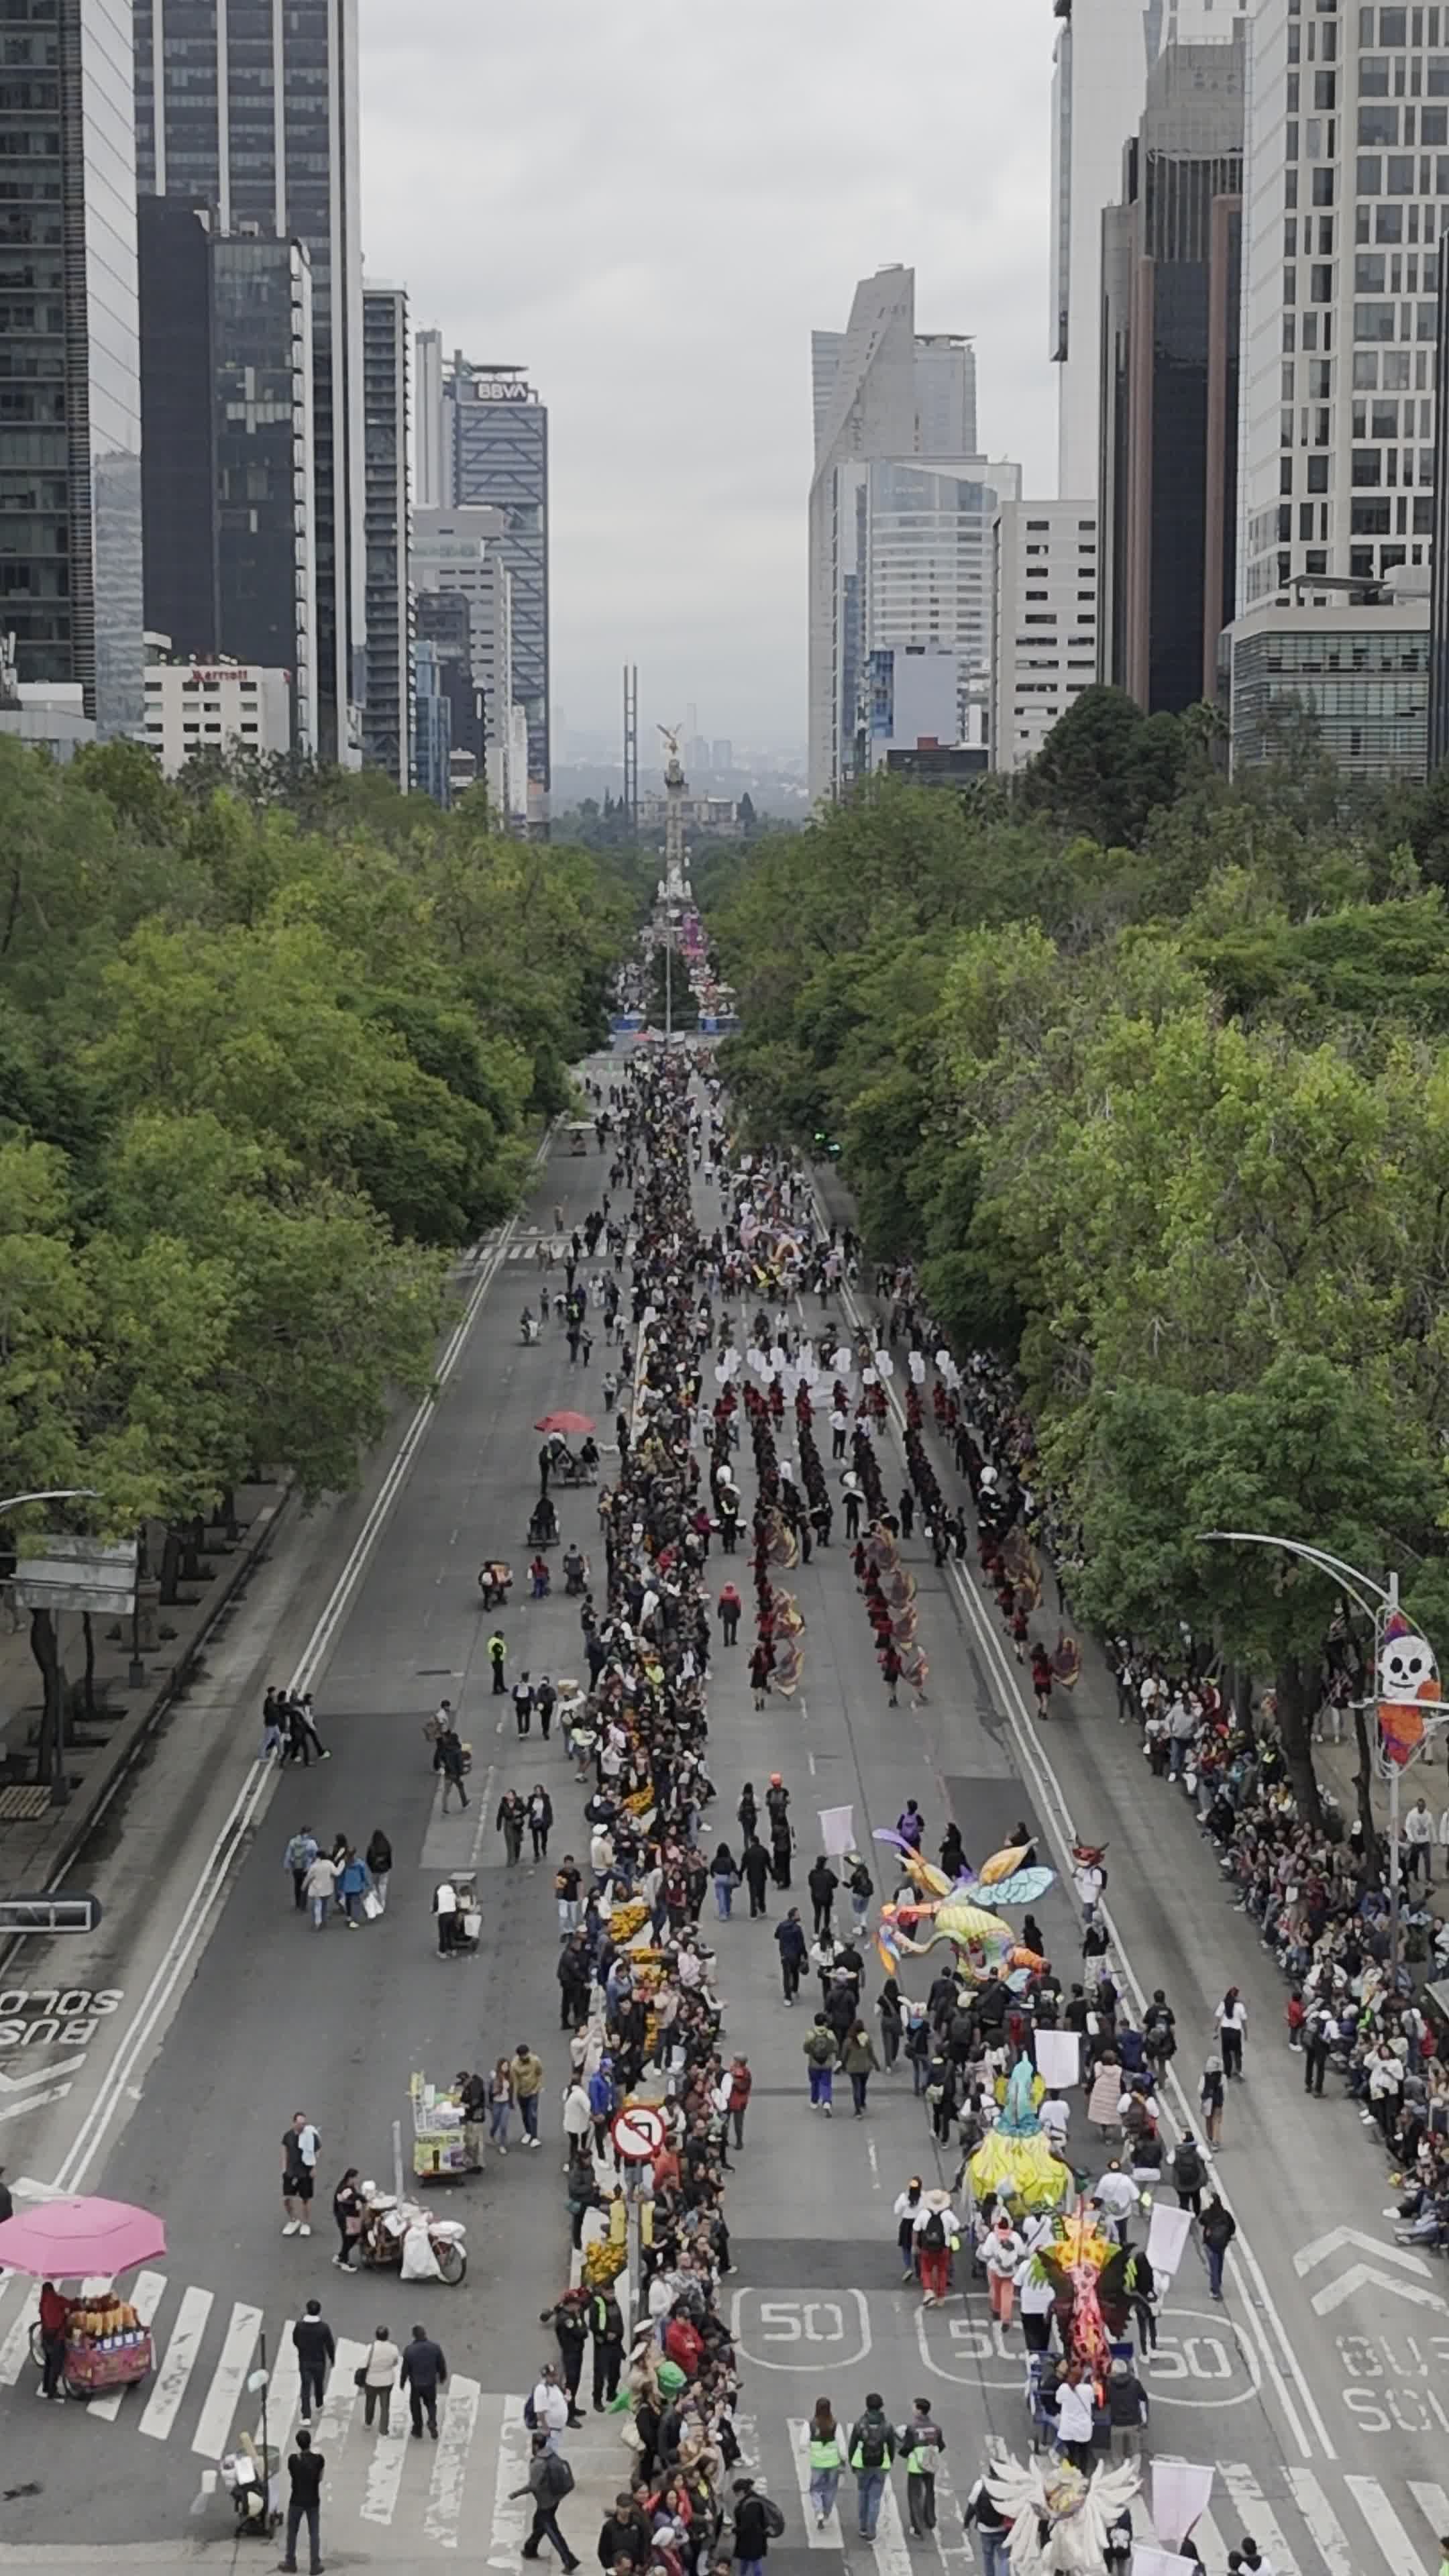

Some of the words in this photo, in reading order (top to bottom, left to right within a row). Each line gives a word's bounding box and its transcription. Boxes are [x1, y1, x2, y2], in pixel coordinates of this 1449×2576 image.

[478, 383, 526, 398] BBVA
[0, 1989, 124, 2015] SOLO
[0, 2018, 99, 2045] BUS
[760, 2302, 843, 2340] 50
[1146, 2337, 1232, 2377] 50
